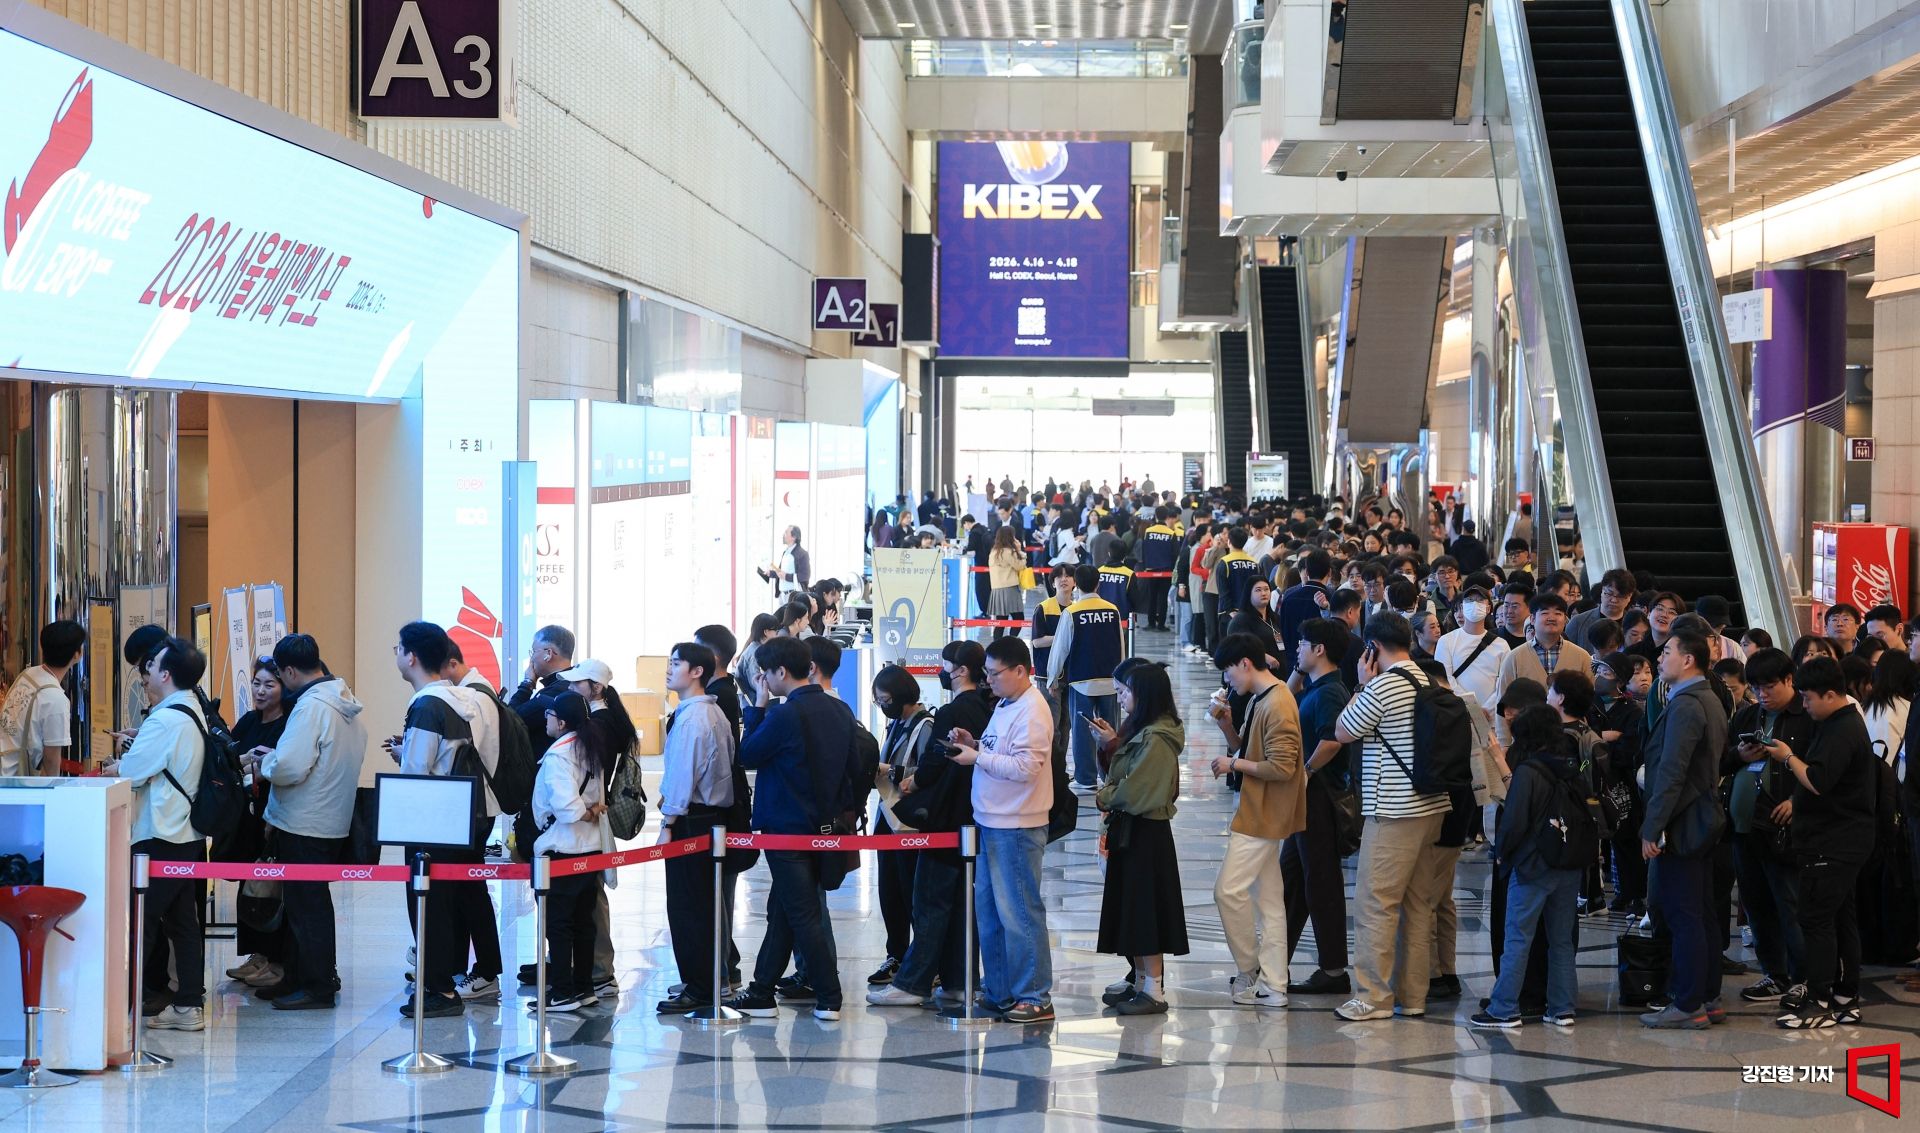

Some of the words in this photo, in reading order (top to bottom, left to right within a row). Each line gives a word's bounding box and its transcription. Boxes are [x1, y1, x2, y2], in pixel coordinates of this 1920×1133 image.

[369, 1, 492, 98] A3
[963, 184, 1103, 219] KIBEX
[72, 180, 151, 241] COFFEE
[989, 256, 1020, 267] 2026.
[1023, 257, 1044, 267] 4.16
[1056, 257, 1078, 267] 4.18
[138, 213, 243, 313] 2026
[210, 231, 351, 327] 서울커피엑스포
[818, 286, 864, 322] A2
[857, 309, 895, 341] A1
[1149, 532, 1170, 542] STAFF
[537, 564, 565, 574] FFEE
[1232, 560, 1257, 570] STAFF
[1099, 572, 1125, 584] STAFF
[1079, 611, 1115, 625] STAFF
[726, 834, 754, 848] coex
[811, 836, 841, 849] coex
[900, 834, 930, 848] coex
[573, 859, 588, 871] coex
[612, 852, 626, 865] coex
[649, 847, 663, 859] coex
[683, 840, 698, 852] coex
[163, 863, 195, 876] coex
[253, 865, 286, 878] coex
[341, 866, 374, 879] coex
[468, 865, 499, 878] coex
